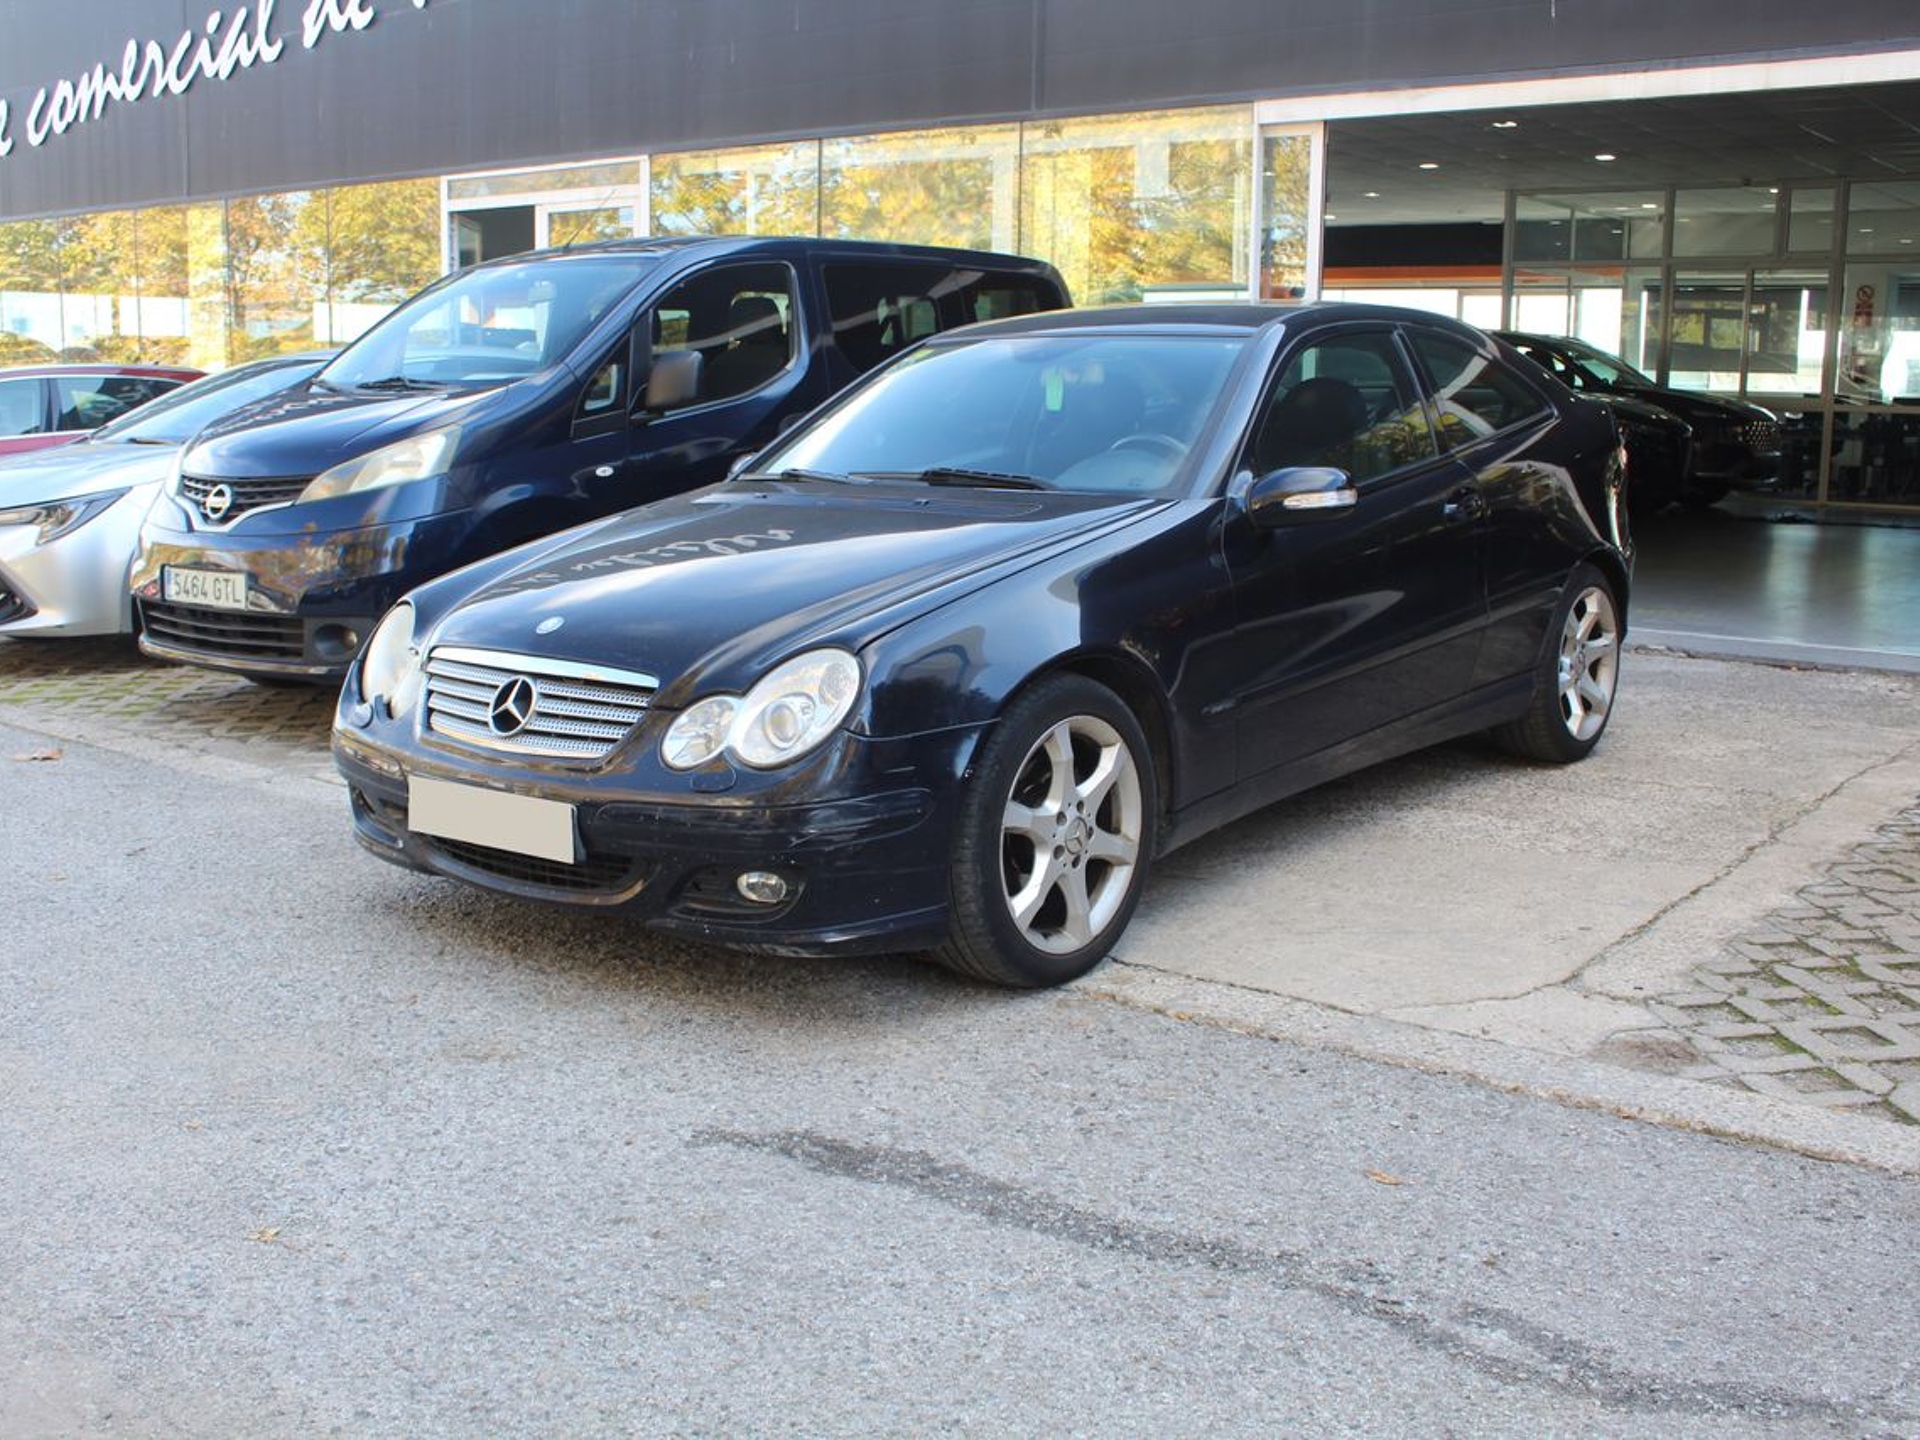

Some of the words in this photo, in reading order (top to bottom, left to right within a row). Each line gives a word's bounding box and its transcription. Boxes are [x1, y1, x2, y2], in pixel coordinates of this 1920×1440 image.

[26, 0, 283, 147] comercial
[174, 572, 208, 599] 5464
[213, 577, 242, 604] GTL
